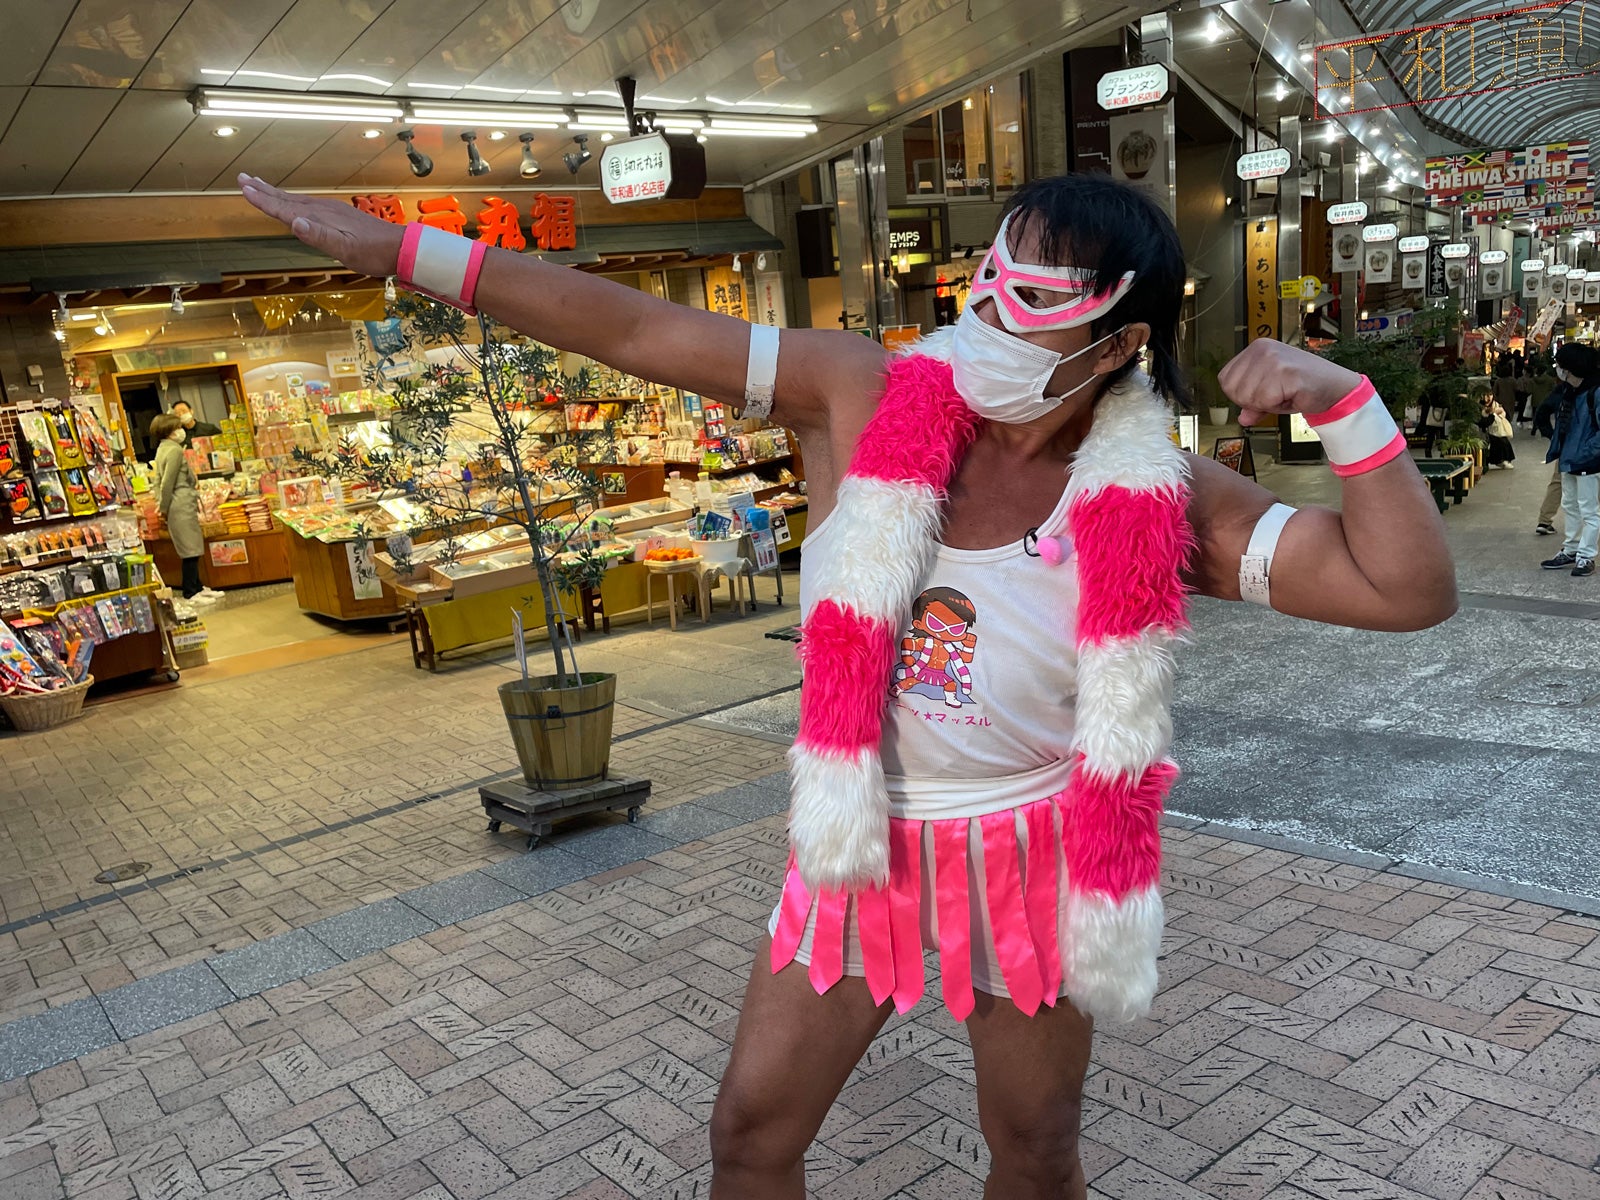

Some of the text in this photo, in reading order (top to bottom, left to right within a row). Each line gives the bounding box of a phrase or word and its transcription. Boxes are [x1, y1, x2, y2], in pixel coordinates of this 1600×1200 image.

[1128, 70, 1158, 81] レストラン
[1105, 90, 1162, 108] 平和通り名店街
[624, 152, 663, 175] 網元丸福
[1438, 159, 1574, 190] HEIWA STREET
[610, 179, 665, 200] 平和通り名店街
[1477, 191, 1581, 212] HEIWA STREET
[1543, 213, 1585, 225] HEIWA
[890, 231, 920, 243] EMPS
[1431, 244, 1444, 295] お食事処
